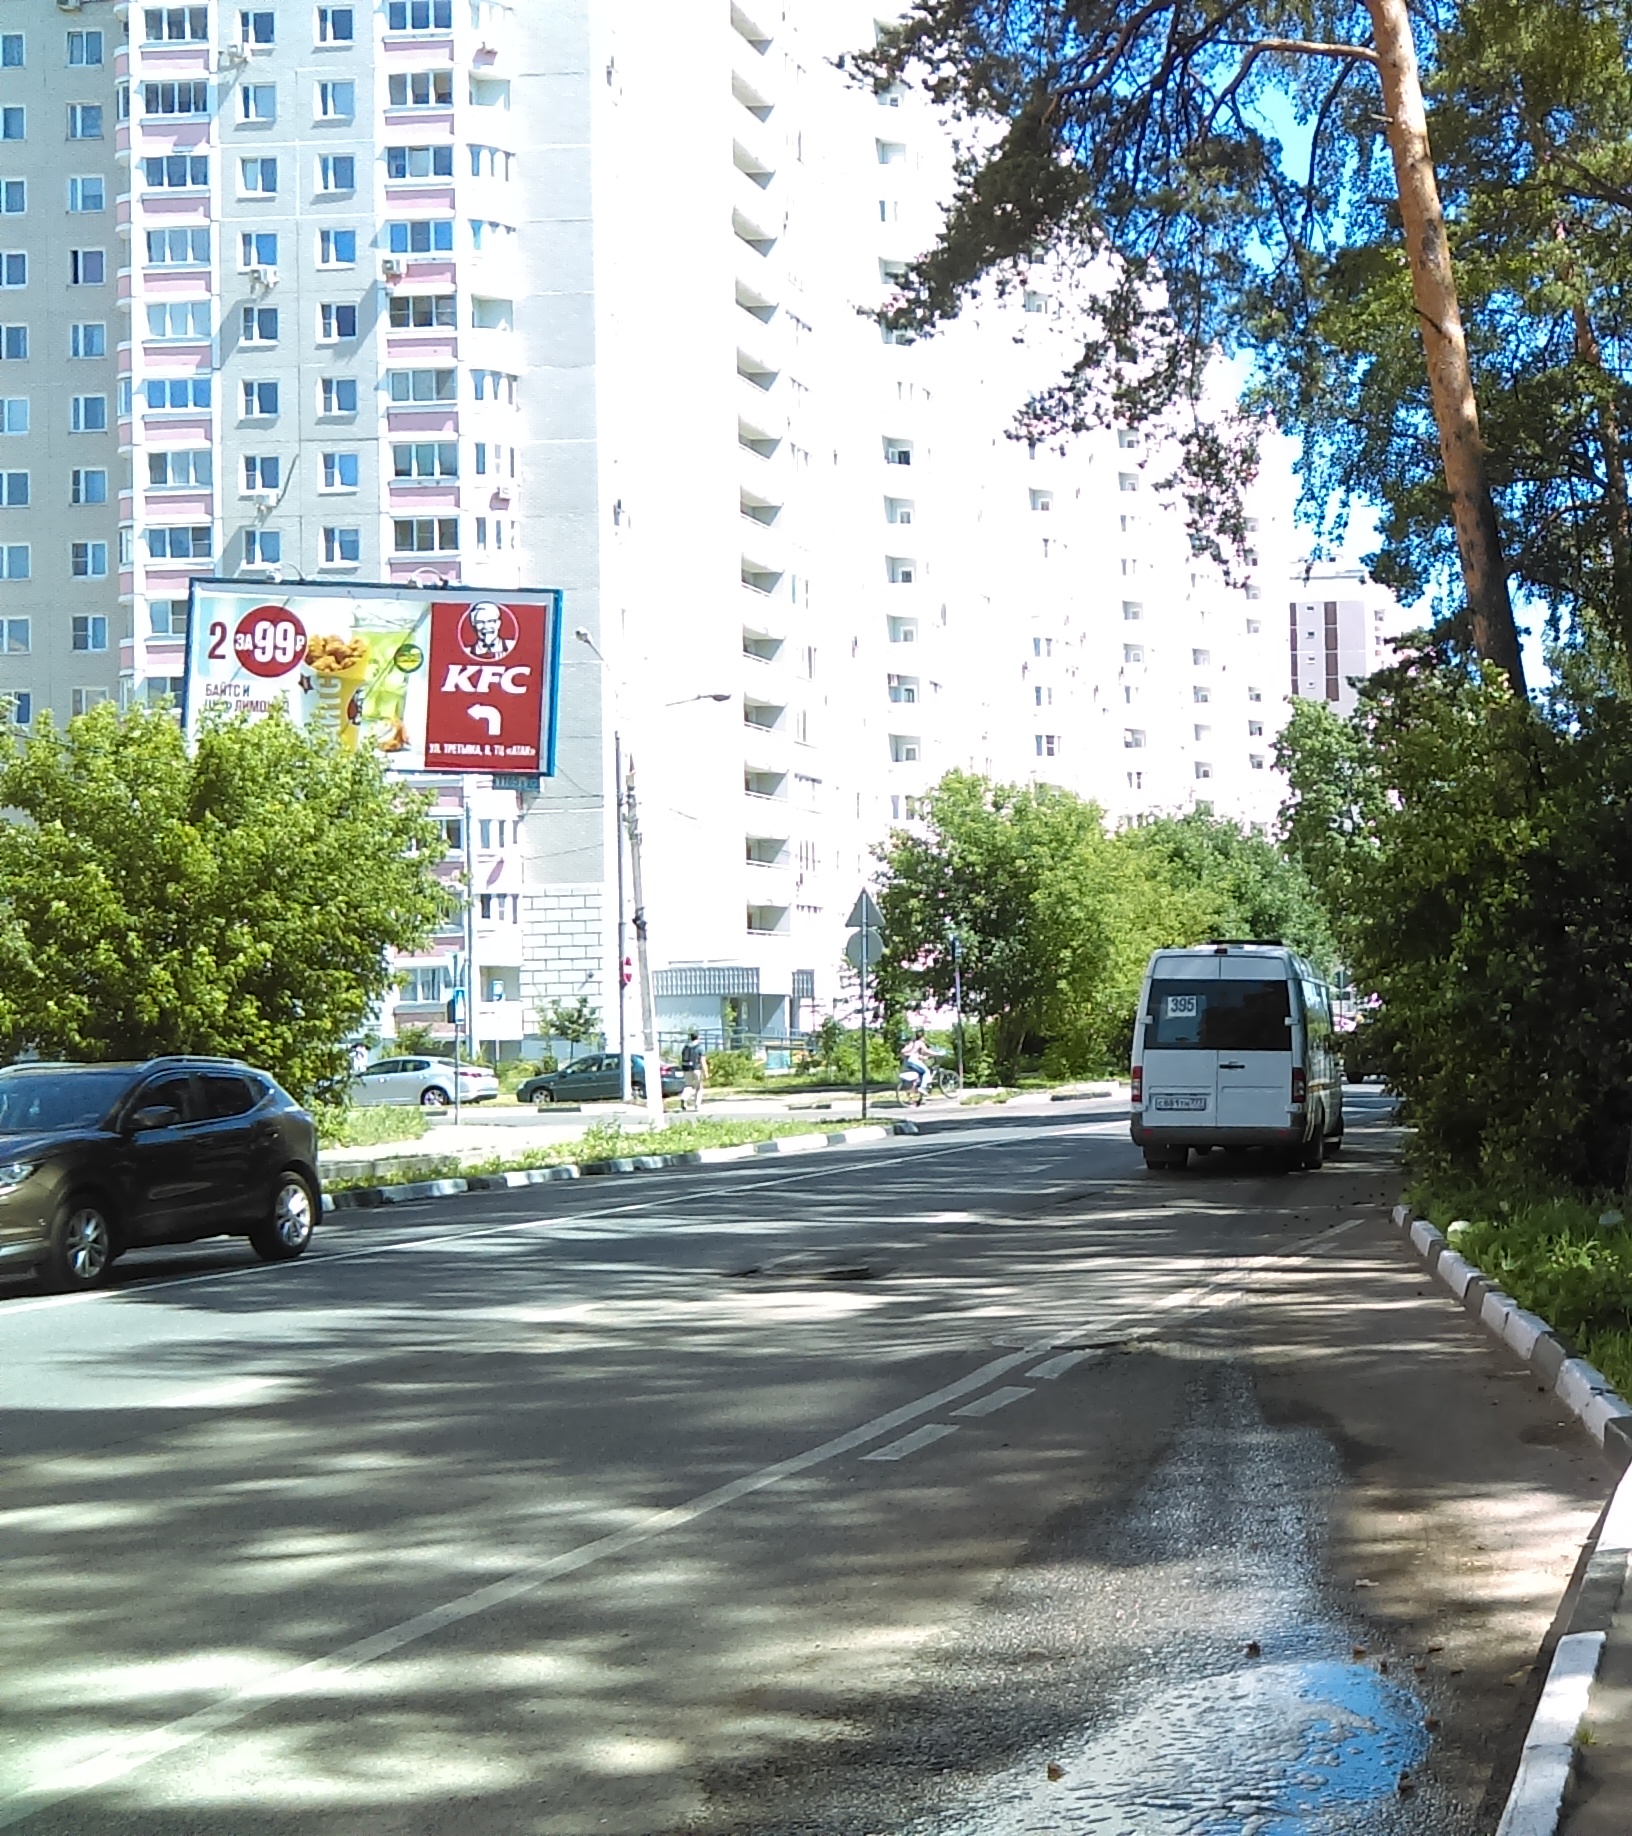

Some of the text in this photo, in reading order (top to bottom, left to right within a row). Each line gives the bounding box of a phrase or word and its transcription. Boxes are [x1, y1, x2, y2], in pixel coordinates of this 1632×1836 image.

[208, 621, 228, 660] 2
[235, 633, 254, 651] ЗА
[205, 681, 251, 697] БАЙТС И
[441, 664, 531, 694] KFC
[1171, 997, 1195, 1013] 395
